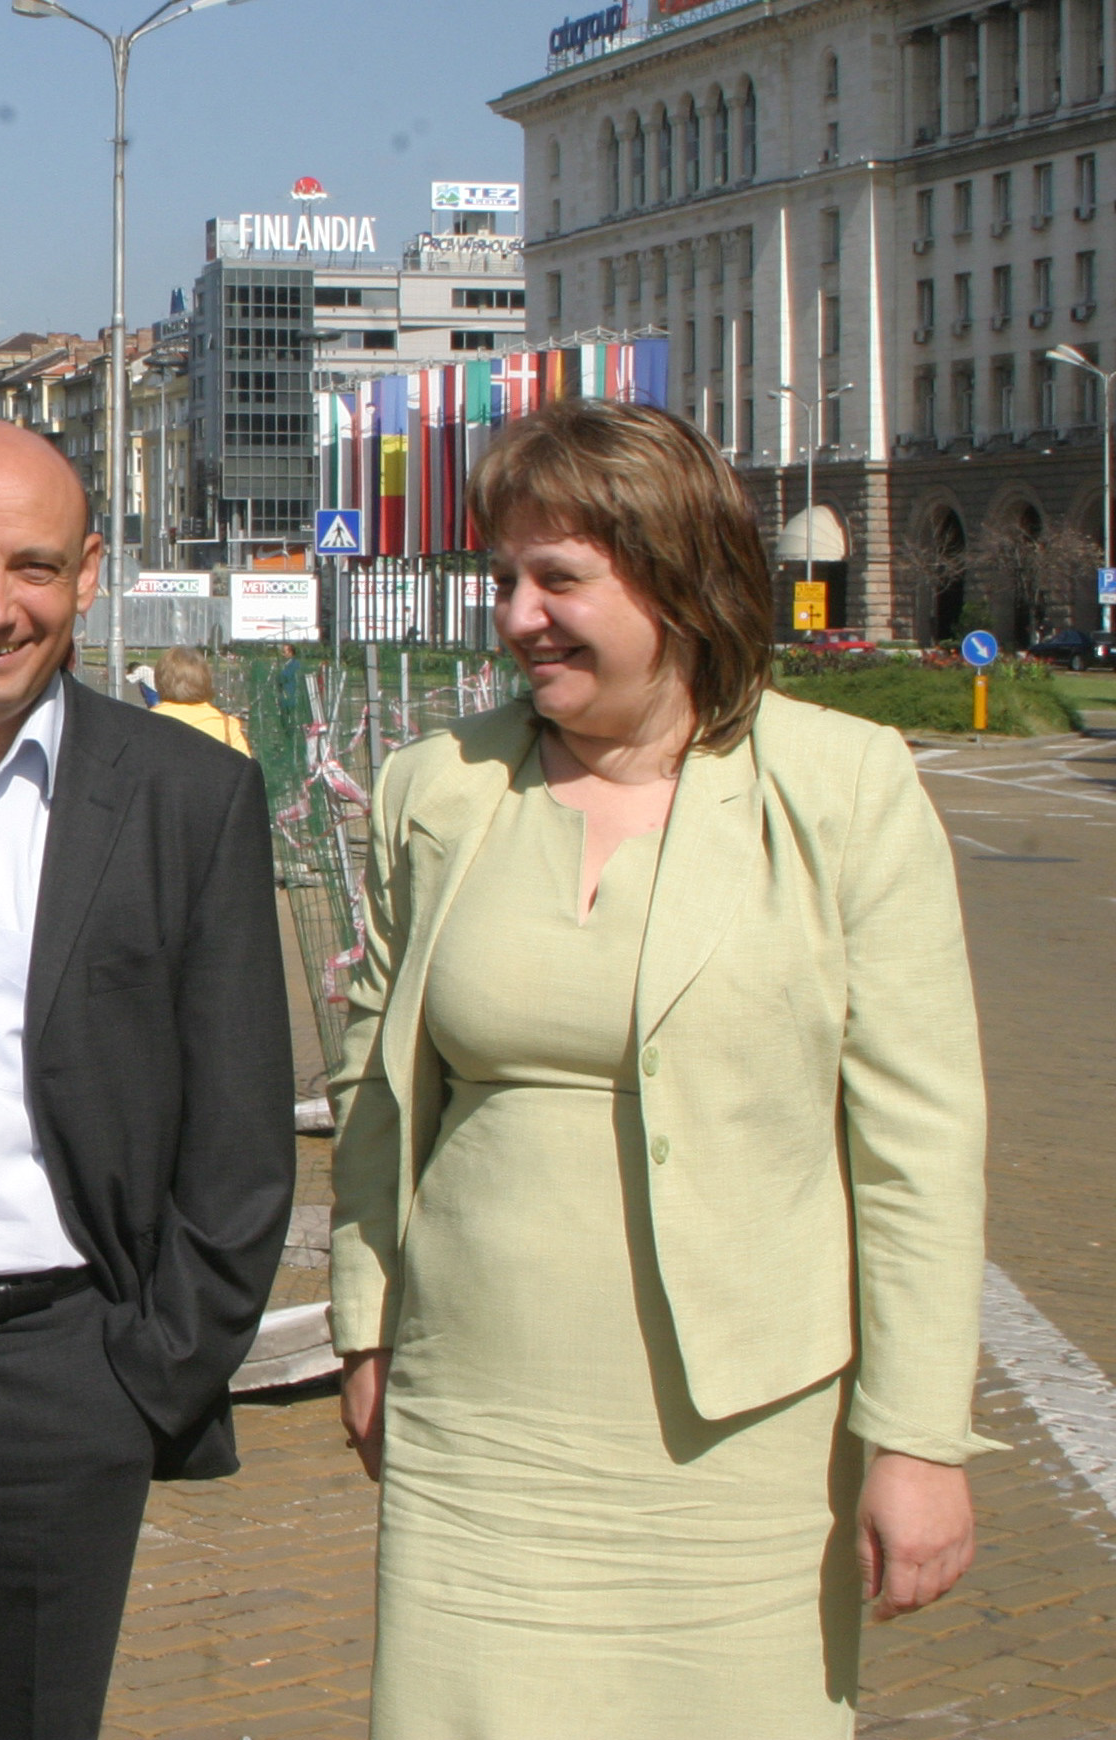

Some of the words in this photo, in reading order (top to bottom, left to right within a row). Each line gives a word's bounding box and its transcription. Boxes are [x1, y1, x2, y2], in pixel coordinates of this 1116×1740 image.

[464, 188, 516, 198] TEZ
[239, 213, 375, 252] FINLANDIA
[242, 580, 309, 594] METROPOLIS
